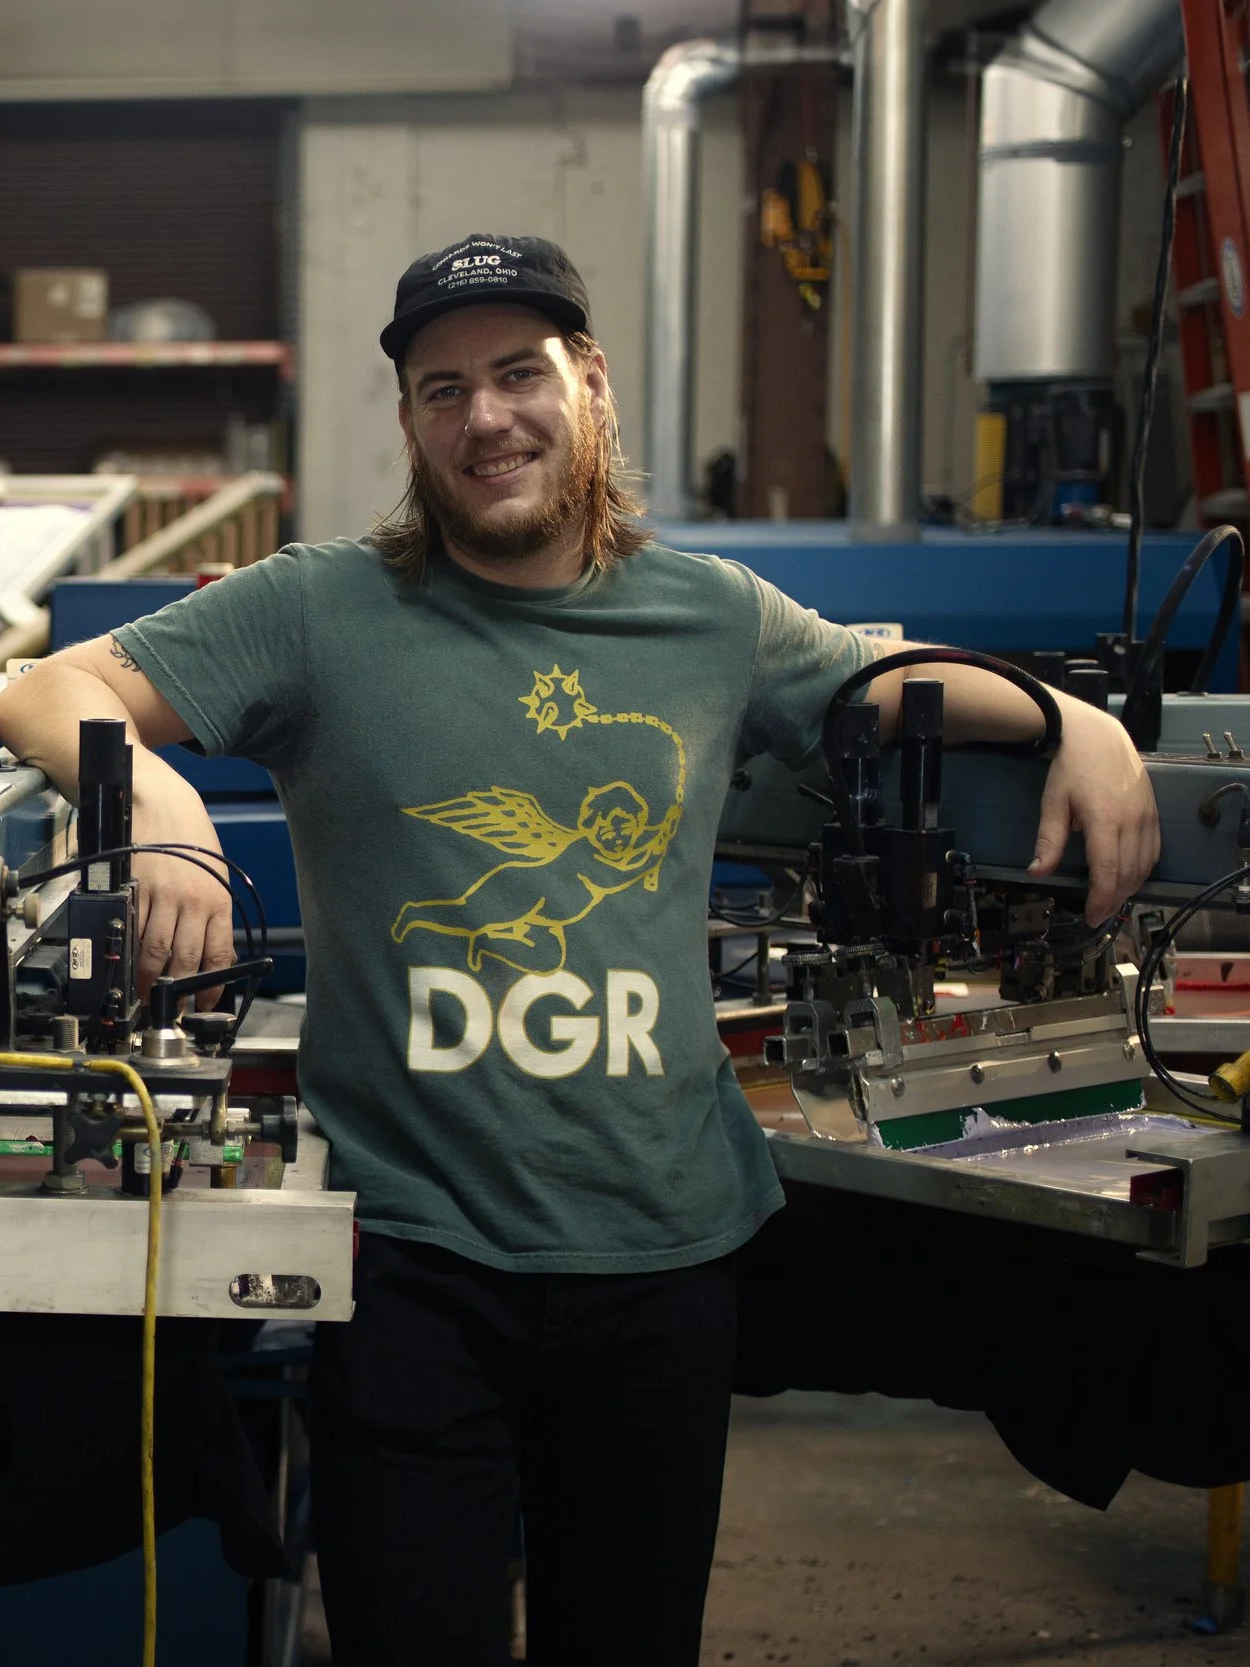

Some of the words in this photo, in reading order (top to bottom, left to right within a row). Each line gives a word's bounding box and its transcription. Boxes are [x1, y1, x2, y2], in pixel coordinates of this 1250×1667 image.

[471, 240, 501, 250] WON'T
[500, 246, 523, 258] LAST
[451, 255, 502, 271] SLUG
[438, 268, 493, 286] CLEVELAND,
[495, 267, 518, 277] OHIO
[447, 278, 468, 290] (216)
[407, 965, 665, 1080] DGR
